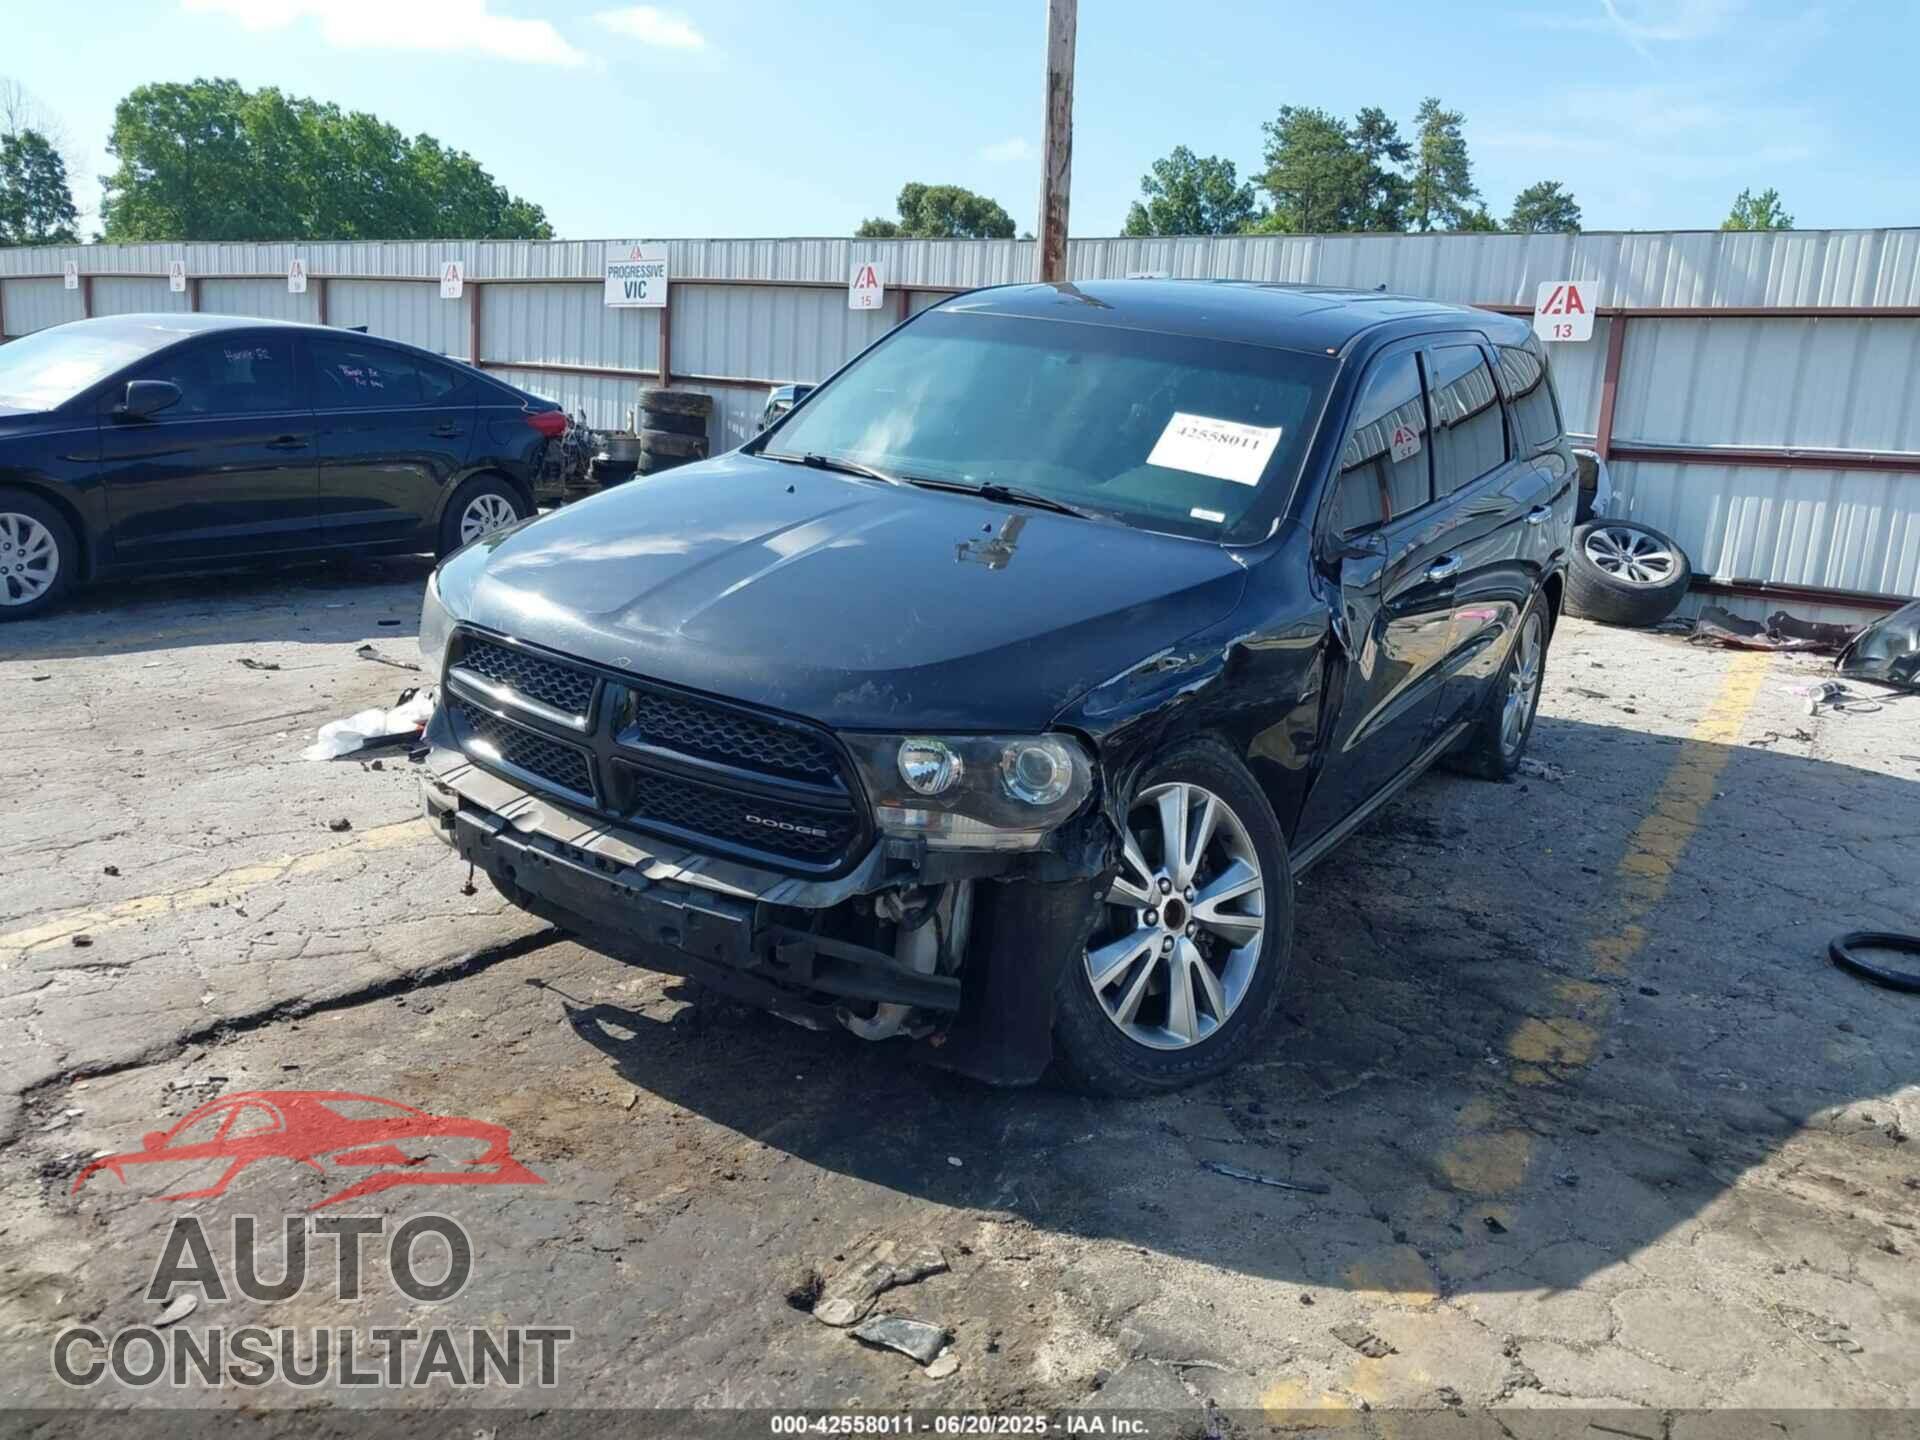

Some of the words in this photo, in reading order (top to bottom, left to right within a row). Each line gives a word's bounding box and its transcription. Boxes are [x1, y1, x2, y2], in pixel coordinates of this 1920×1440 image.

[608, 265, 665, 279] PROGRESSIVE
[624, 280, 647, 299] VIC
[861, 295, 872, 306] 15
[1553, 324, 1573, 339] 13
[1177, 426, 1260, 450] 42558011
[745, 815, 827, 837] DODGE
